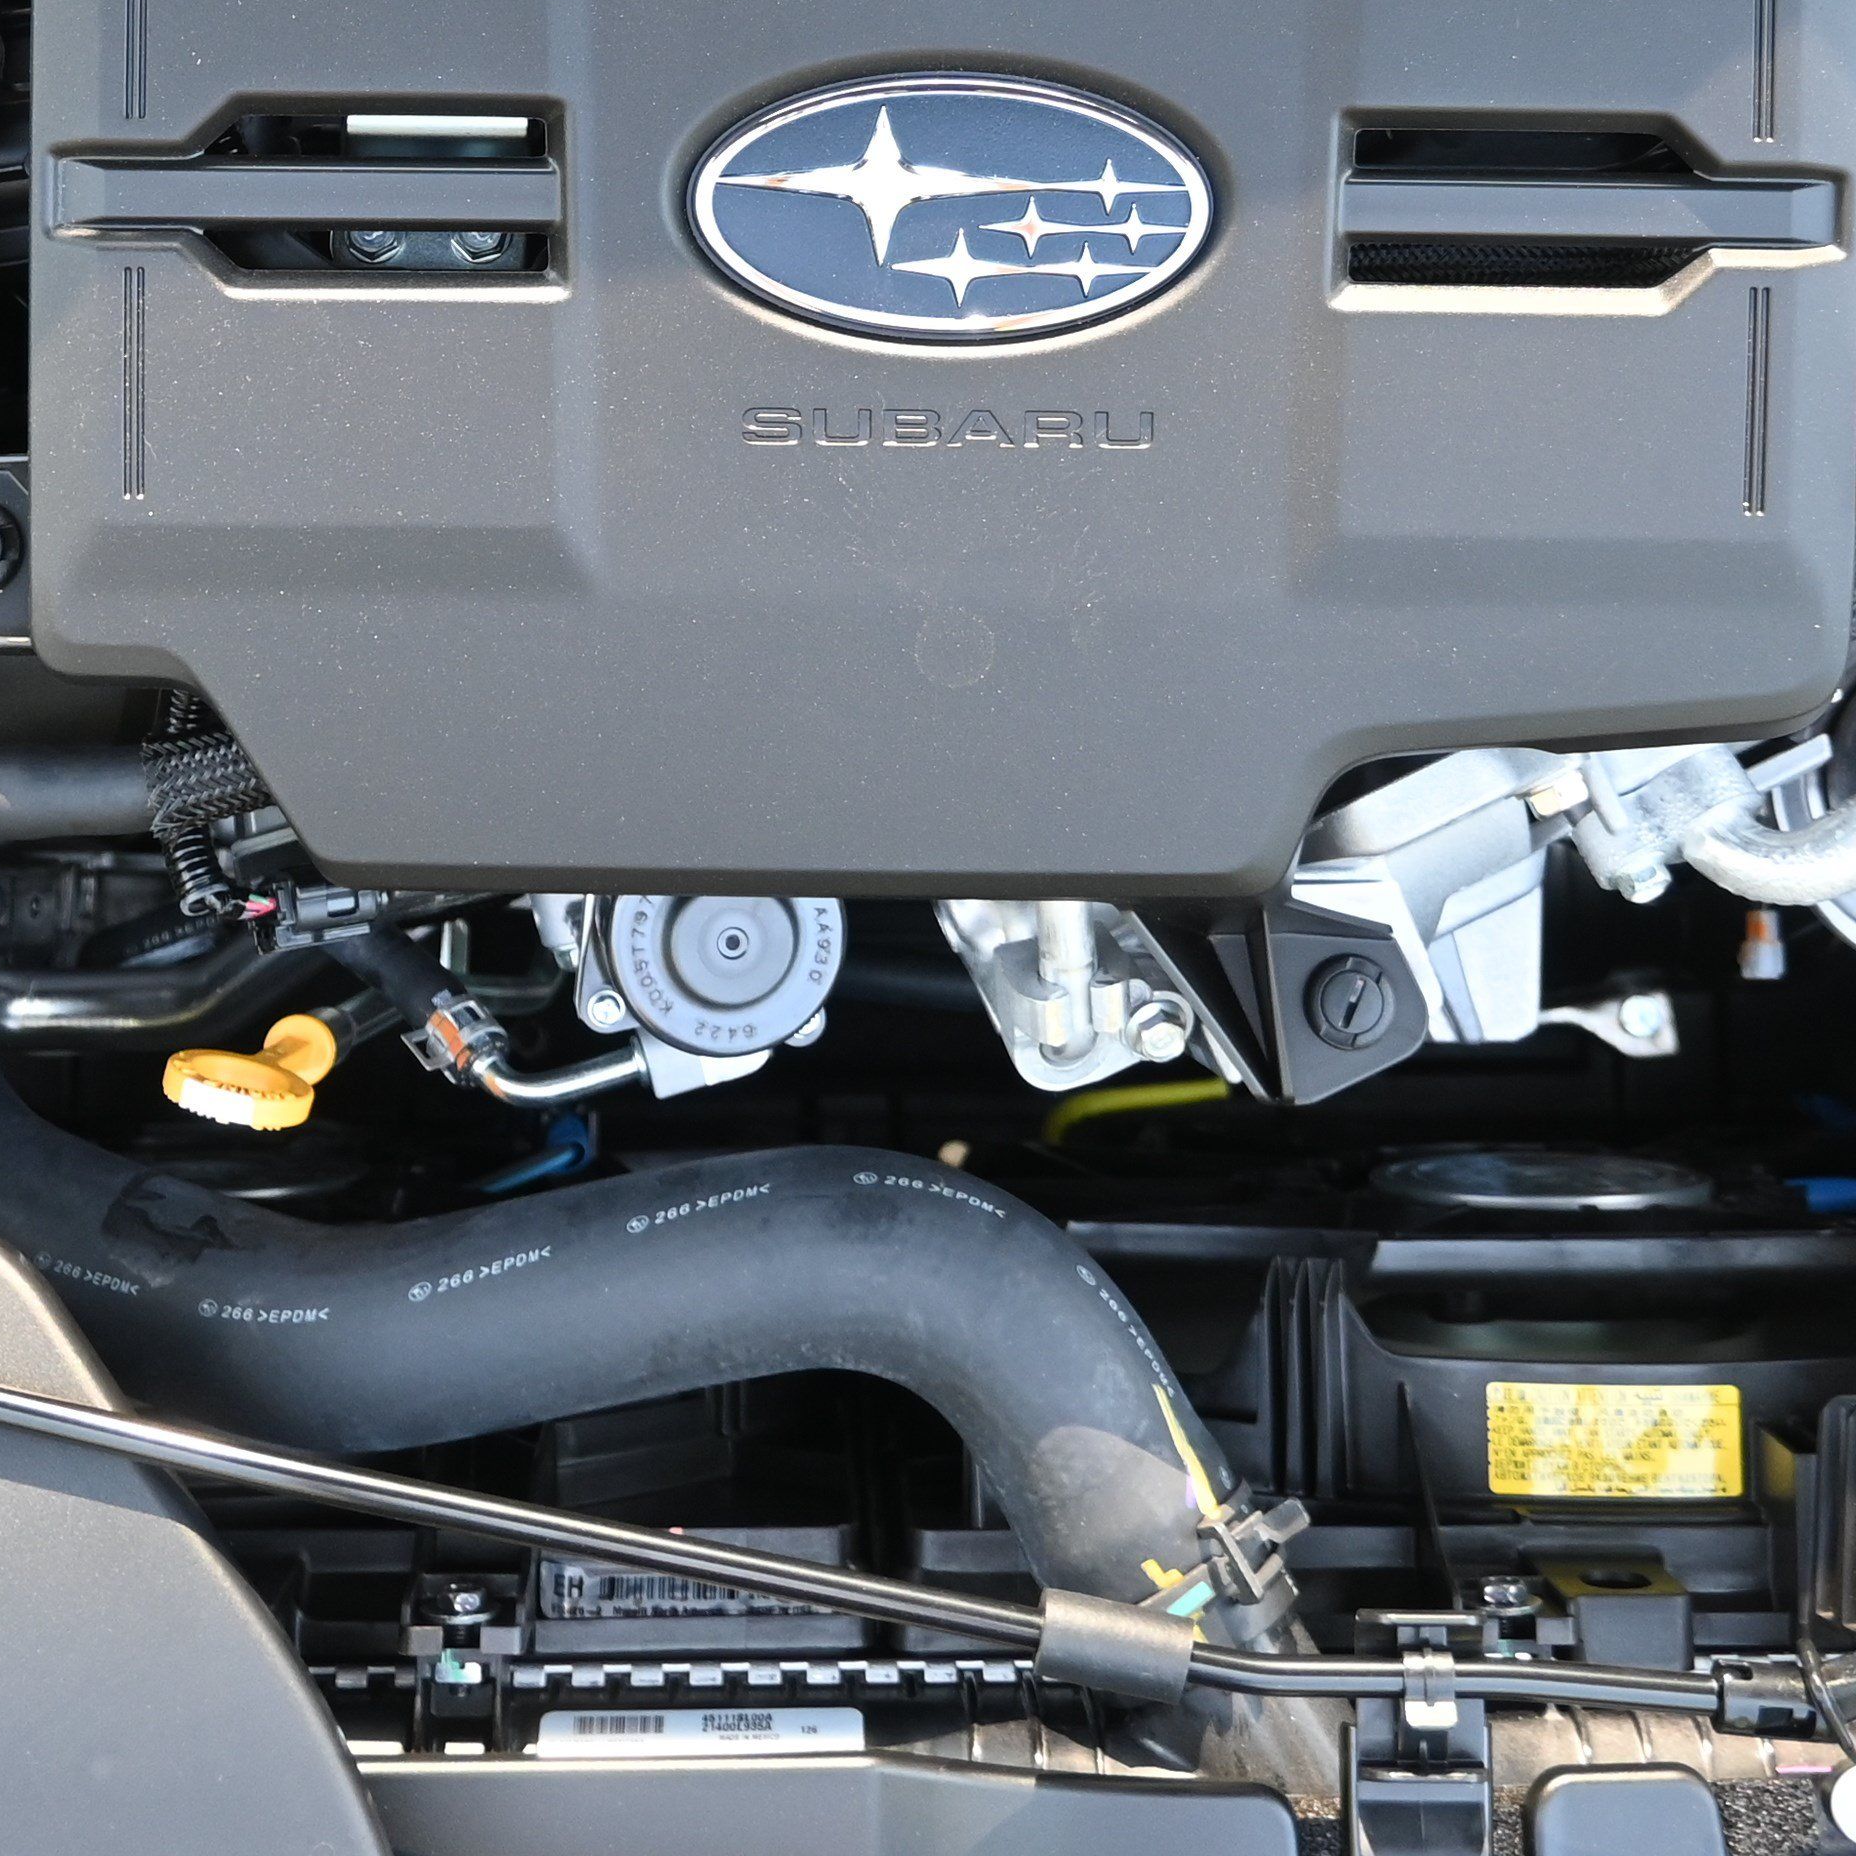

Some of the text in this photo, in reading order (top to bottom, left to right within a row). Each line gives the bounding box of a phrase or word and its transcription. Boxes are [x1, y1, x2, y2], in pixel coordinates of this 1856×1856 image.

[740, 404, 1158, 452] SUBARU
[694, 1020, 757, 1039] 6422
[882, 1171, 924, 1193] 266
[651, 1181, 772, 1225] 266 >EPDM<
[52, 1258, 82, 1279] 266
[433, 1244, 554, 1293] 266 >EPDM<
[220, 1303, 329, 1326] 266 >EPDM<
[553, 1572, 583, 1598] EH
